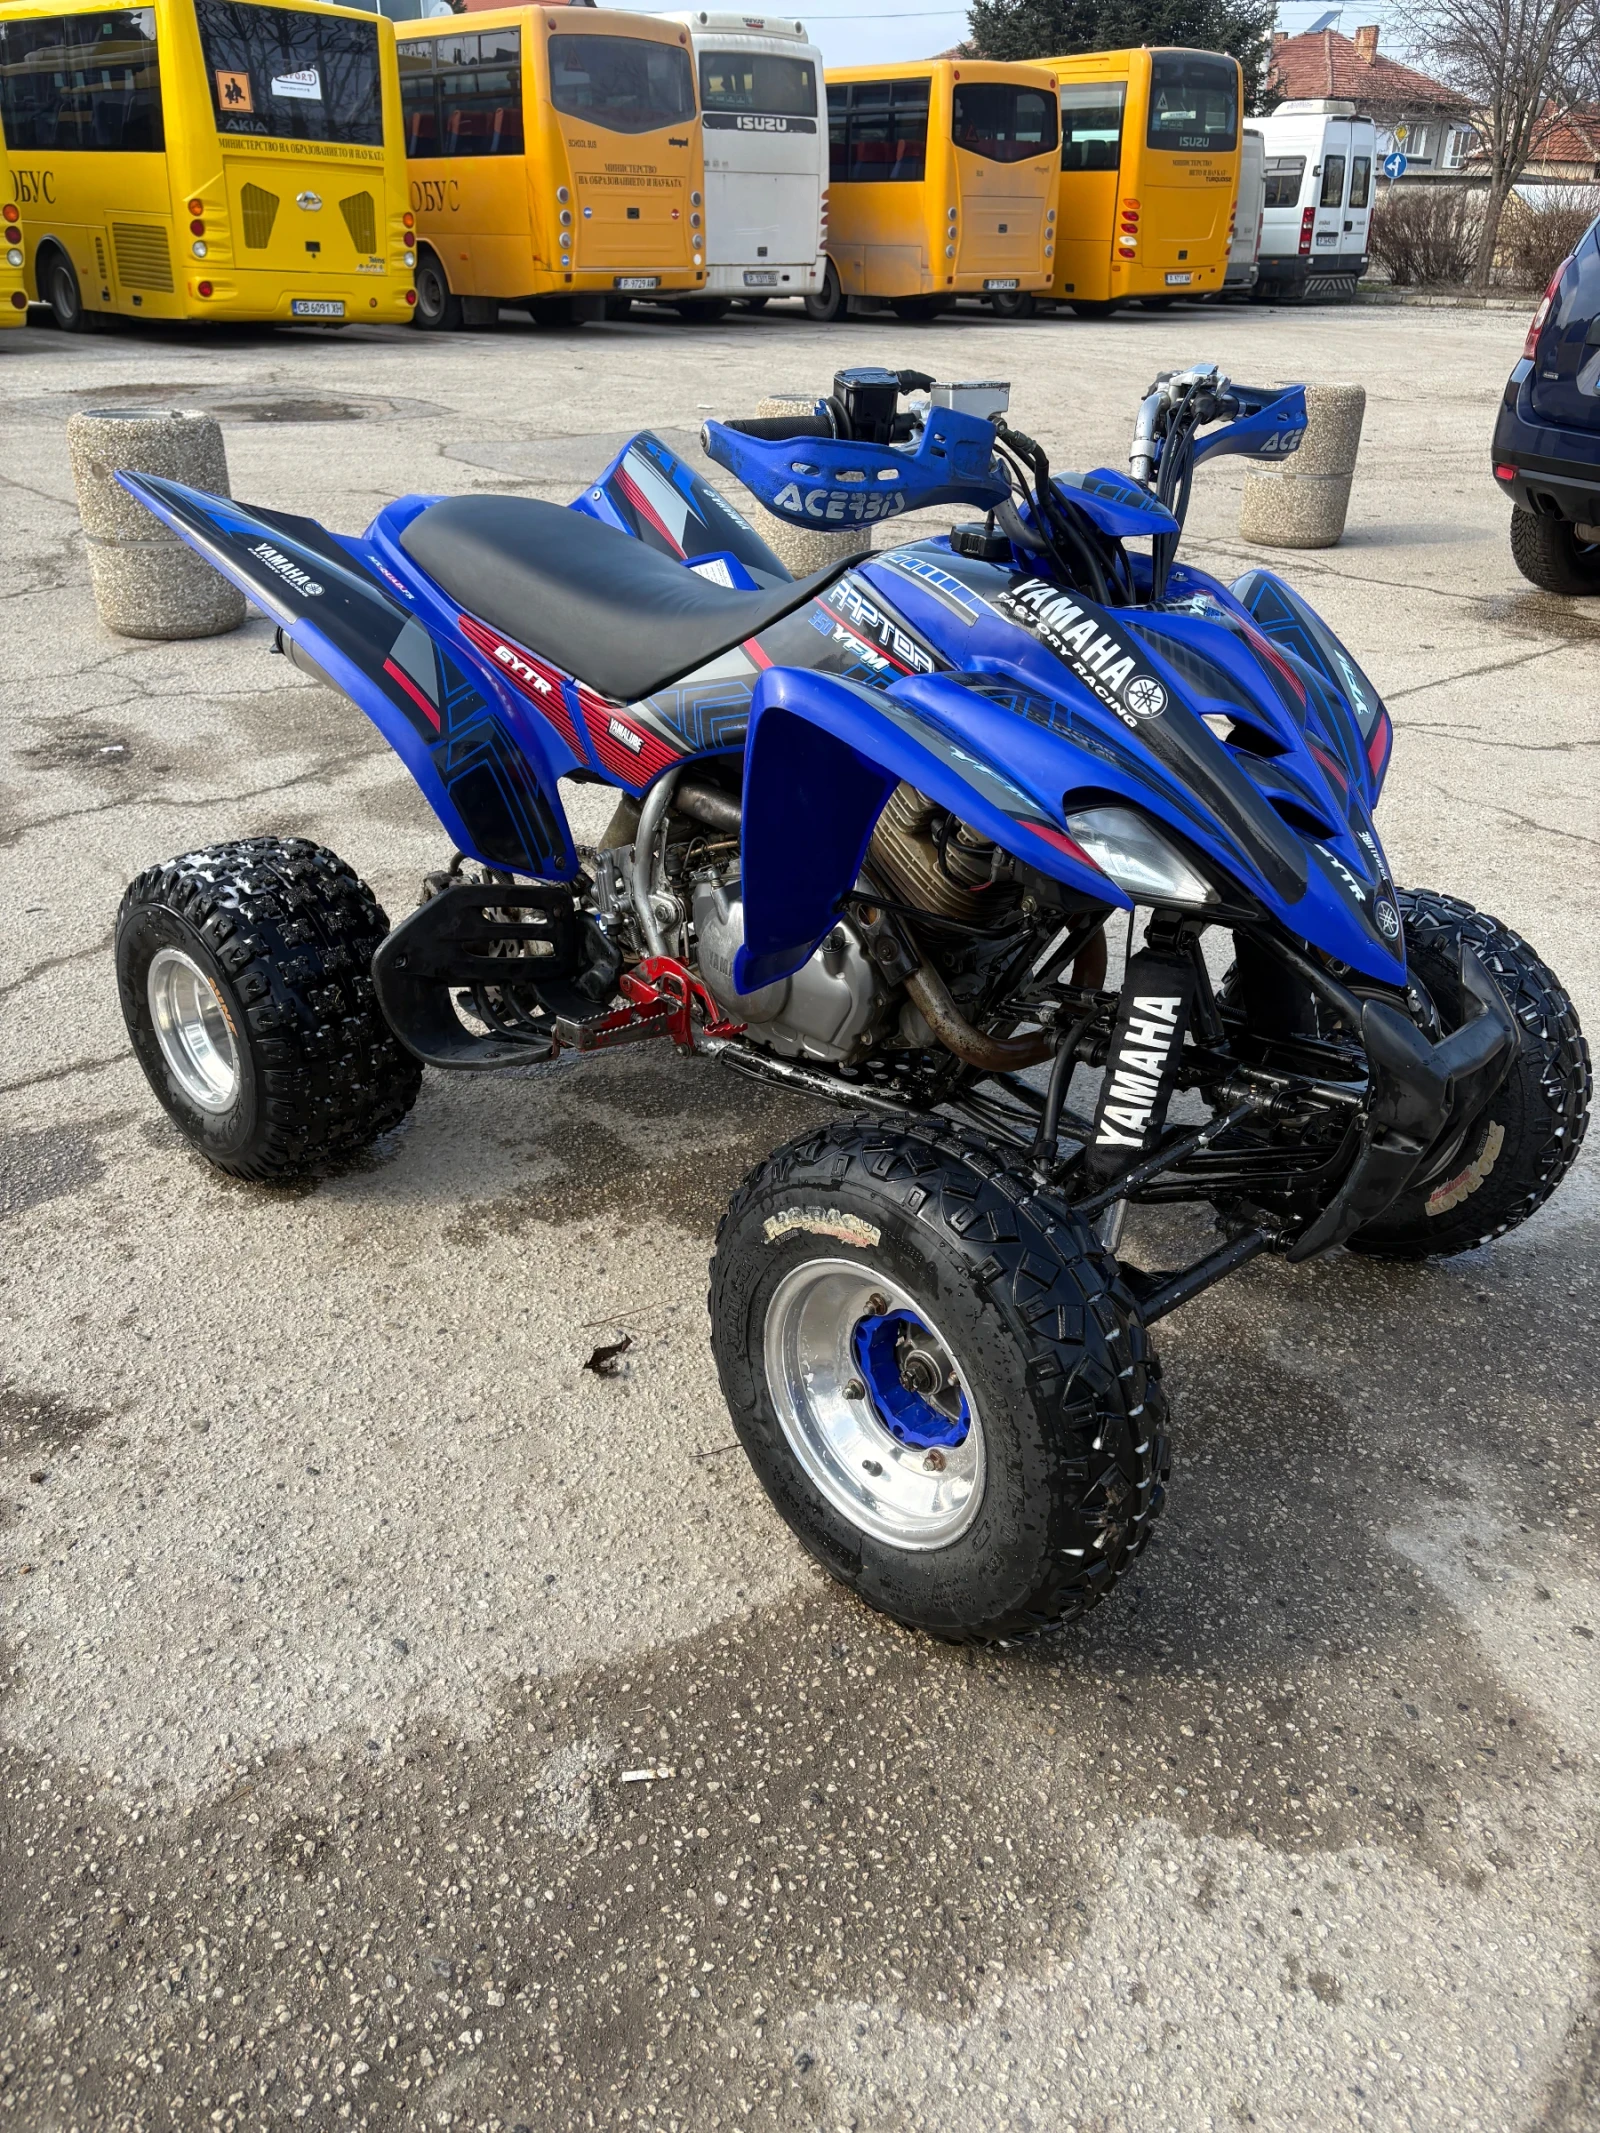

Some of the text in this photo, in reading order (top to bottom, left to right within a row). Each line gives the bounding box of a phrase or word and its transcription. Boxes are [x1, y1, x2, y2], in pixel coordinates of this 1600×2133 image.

[225, 119, 268, 133] AKIA
[736, 116, 787, 131] ISUZU
[1179, 136, 1210, 148] ISUZU
[218, 138, 279, 151] МИНИСТЕРСТВО
[279, 143, 291, 153] НА
[291, 143, 348, 158] ОБРАЗОВАНИЕТО
[578, 176, 587, 185] НА
[589, 176, 646, 187] ОБРАЗОВАНИЕТО
[604, 163, 657, 174] МИНИСТЕРСТВО
[410, 179, 461, 213] ОБУС
[773, 482, 906, 520] ACERBIS
[247, 547, 309, 597] FACTORY RACING
[254, 542, 311, 596] YAMAHA
[828, 579, 936, 674] RAPTOR
[1011, 578, 1137, 692] YAMAHA
[831, 622, 891, 673] YFM
[997, 592, 1138, 728] FACTORY RACING
[493, 645, 553, 696] GYTR
[610, 717, 645, 750] YAMALUBE
[1095, 996, 1182, 1148] YAMAHA
